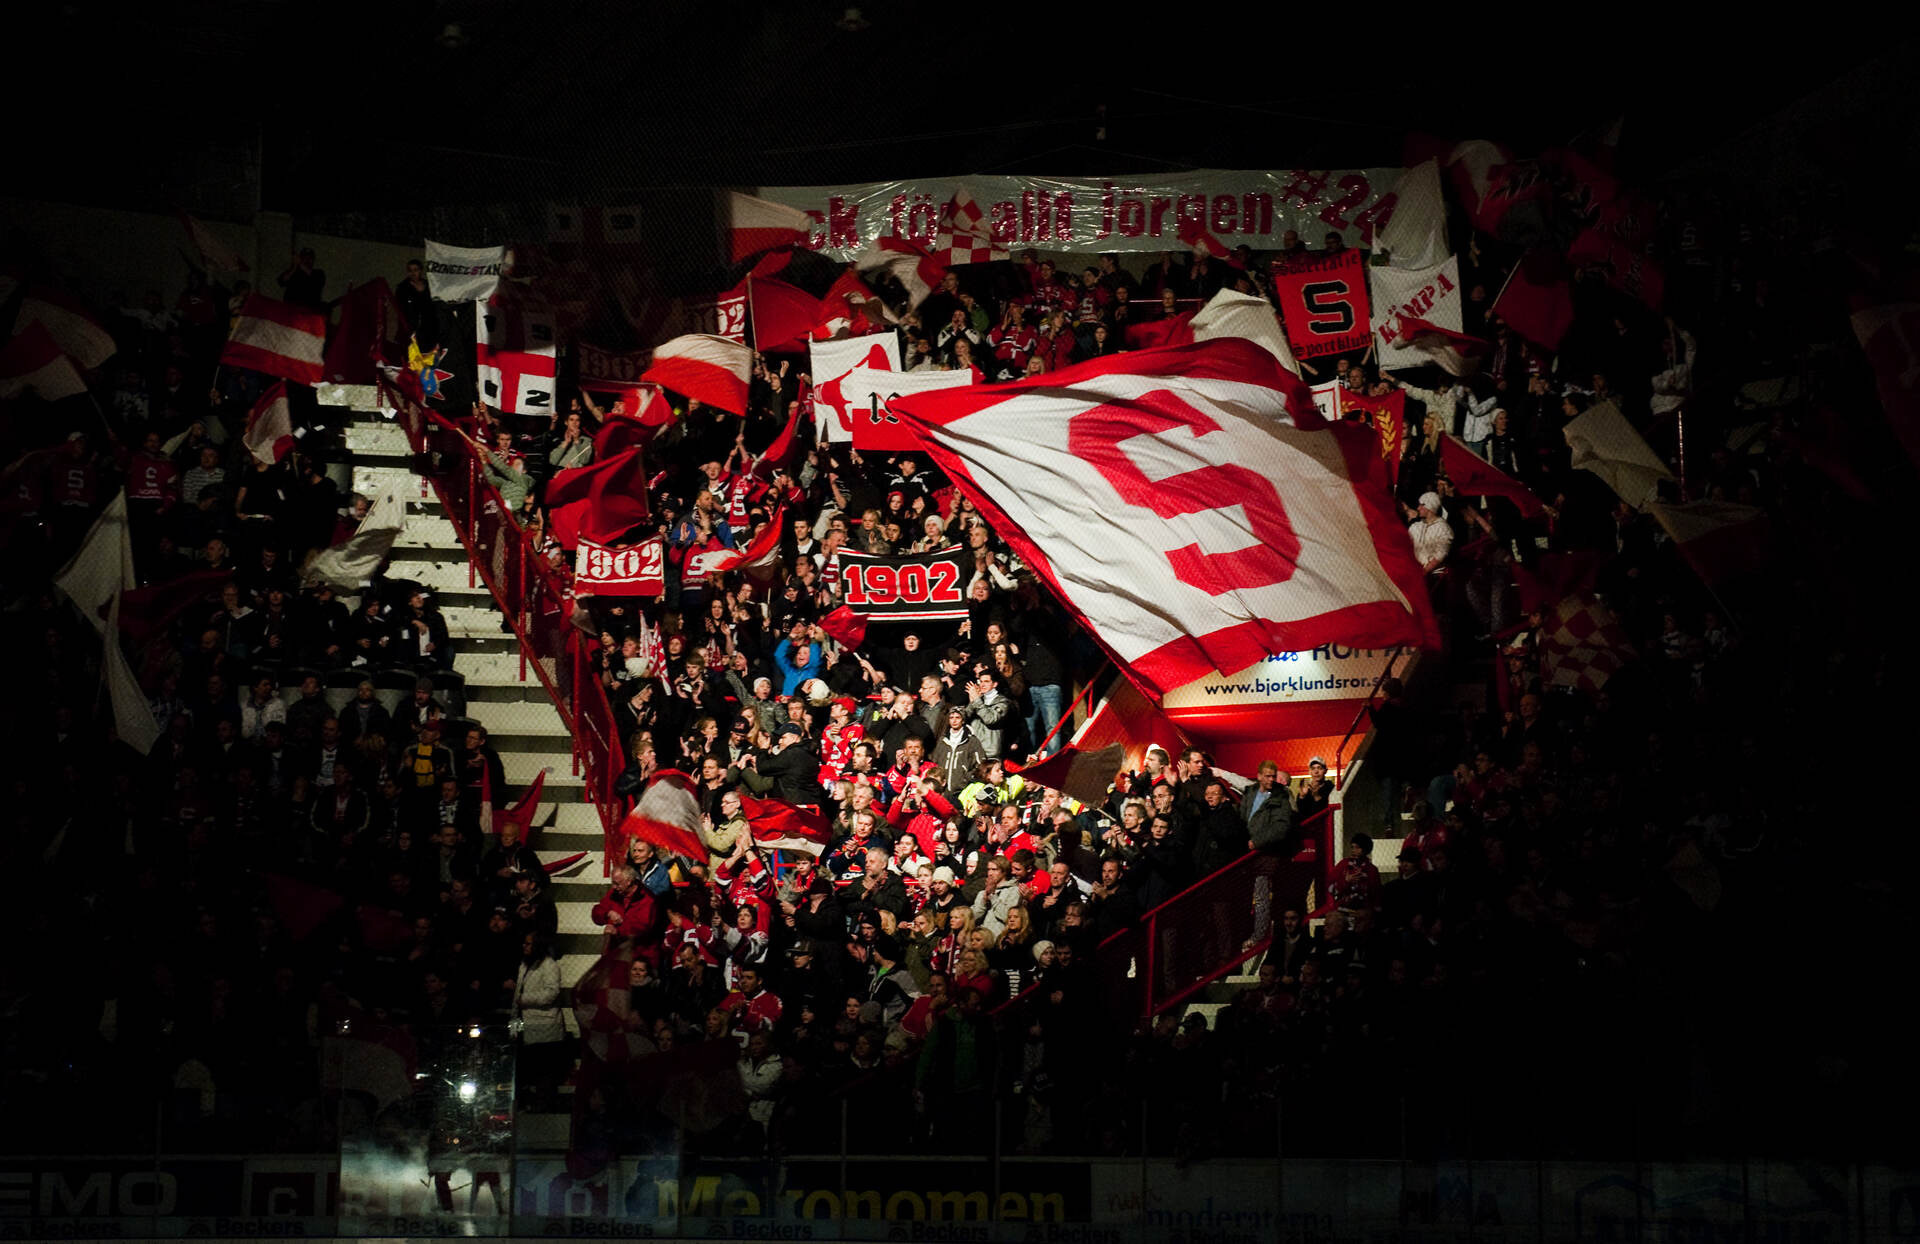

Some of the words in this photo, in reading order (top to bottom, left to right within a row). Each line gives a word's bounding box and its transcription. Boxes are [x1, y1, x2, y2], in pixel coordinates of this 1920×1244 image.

[990, 189, 1074, 243] allt
[1280, 168, 1398, 246] #24
[1301, 280, 1355, 335] S
[1068, 389, 1302, 597] S
[576, 541, 663, 579] 1902
[842, 559, 962, 605] 1902
[1204, 673, 1385, 696] www.bjorklundsror.s
[216, 1219, 304, 1237] Beckers
[393, 1217, 474, 1236] Becke
[570, 1218, 654, 1237] Beckers
[733, 1219, 813, 1240] Beckers
[911, 1221, 989, 1241] Beckers
